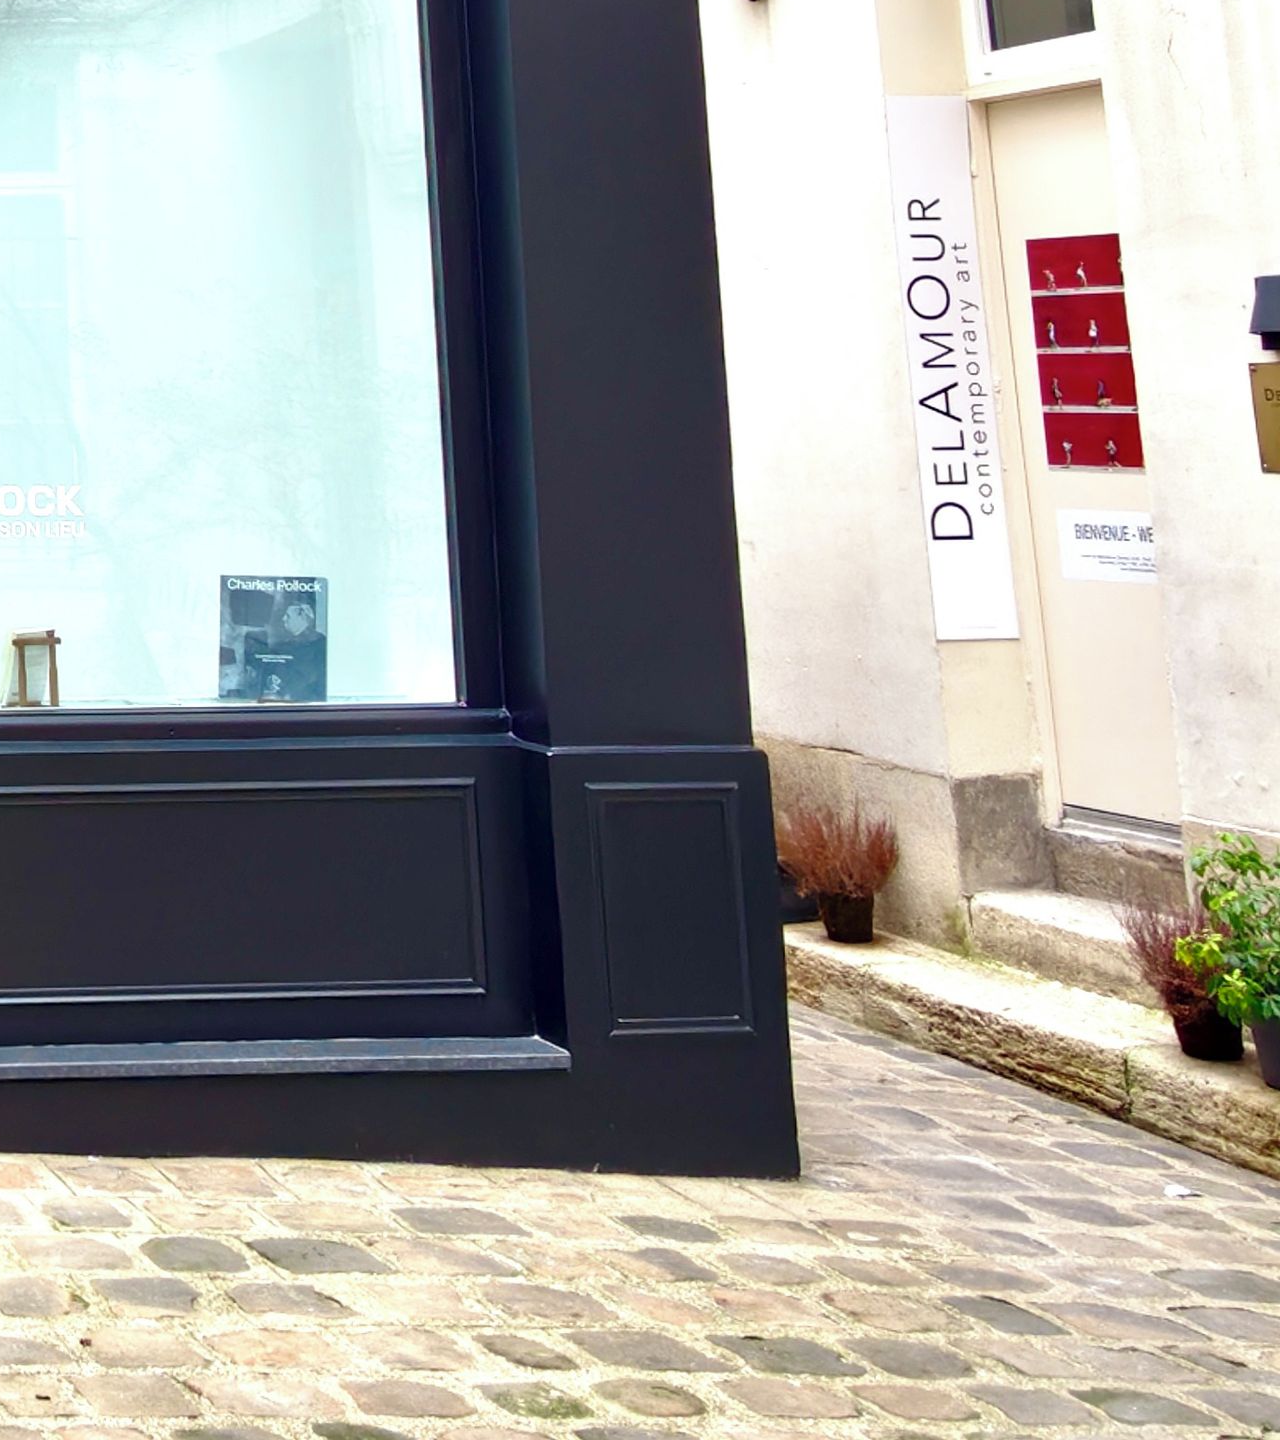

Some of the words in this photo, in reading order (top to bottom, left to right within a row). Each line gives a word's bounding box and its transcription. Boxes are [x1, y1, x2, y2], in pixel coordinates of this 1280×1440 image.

[951, 241, 970, 283] art
[906, 197, 975, 541] DELAMOUR
[954, 298, 996, 516] contemporary
[44, 520, 86, 538] LIEU
[1074, 523, 1131, 542] BIENVENUE
[227, 578, 274, 591] Charles
[276, 579, 322, 593] Pollock
